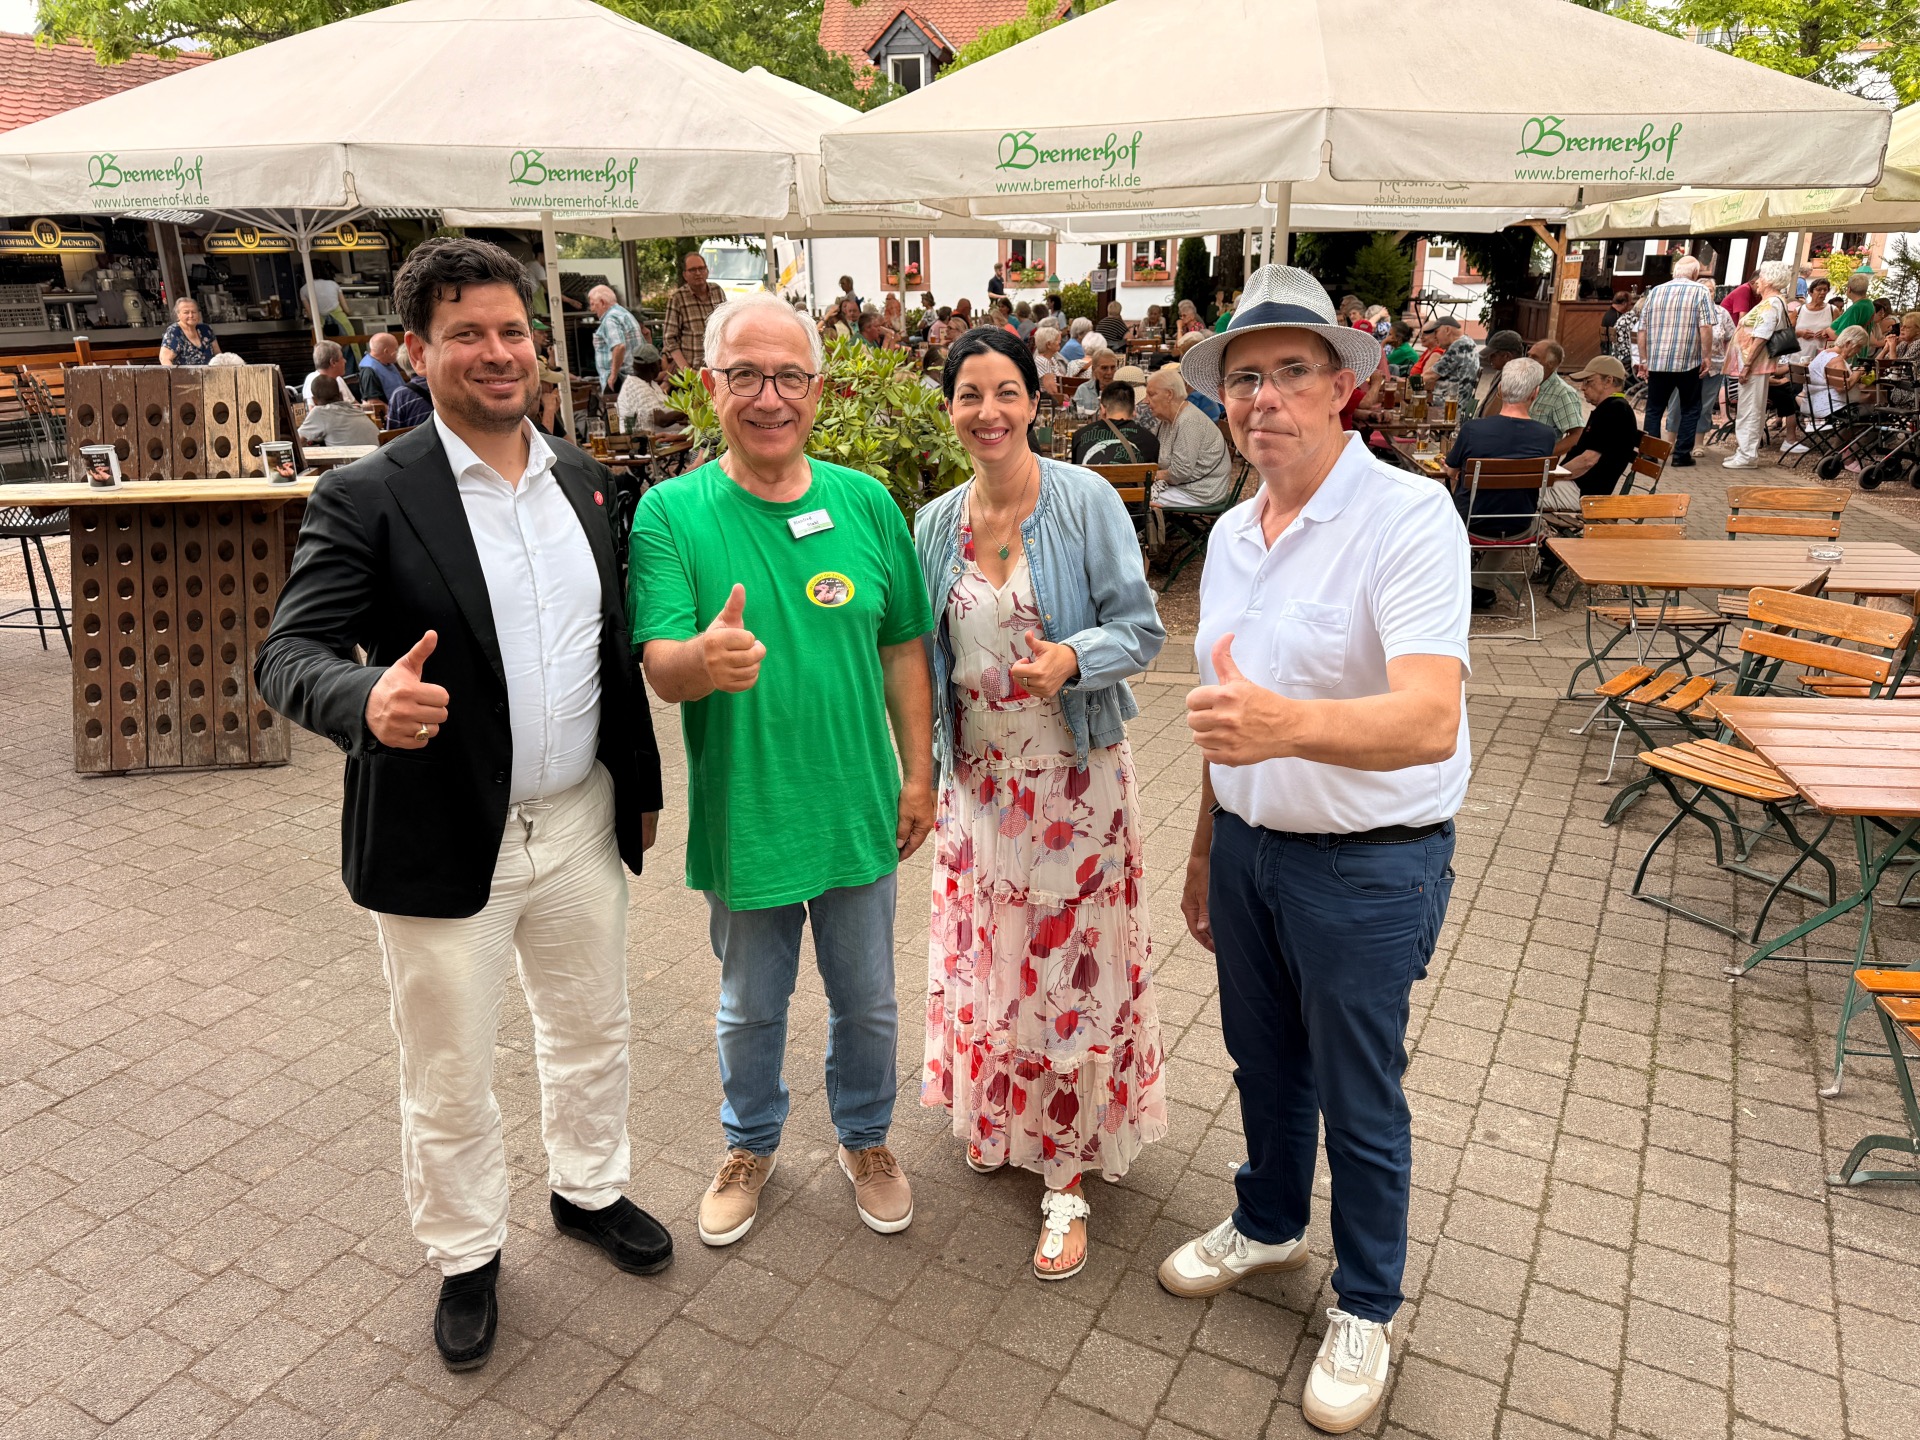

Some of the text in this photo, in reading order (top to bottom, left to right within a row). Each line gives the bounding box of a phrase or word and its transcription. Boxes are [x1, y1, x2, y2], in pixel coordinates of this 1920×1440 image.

[1516, 115, 1683, 164] Bremerhof
[995, 130, 1143, 172] Bremerhof
[88, 153, 203, 190] Bremerhof
[509, 149, 639, 193] Bremerhof
[1514, 166, 1675, 181] www.bremerhof-kl.de
[995, 173, 1141, 193] www.bremerhof-kl.de
[92, 193, 210, 209] www.bremerhof-kl.de
[510, 194, 639, 209] www.bremerhof-kl.de
[0, 238, 97, 247] HOFBRÄU MÜNCHEN
[41, 232, 55, 243] HB
[211, 239, 239, 247] HOFBRÄU
[244, 233, 255, 243] HB
